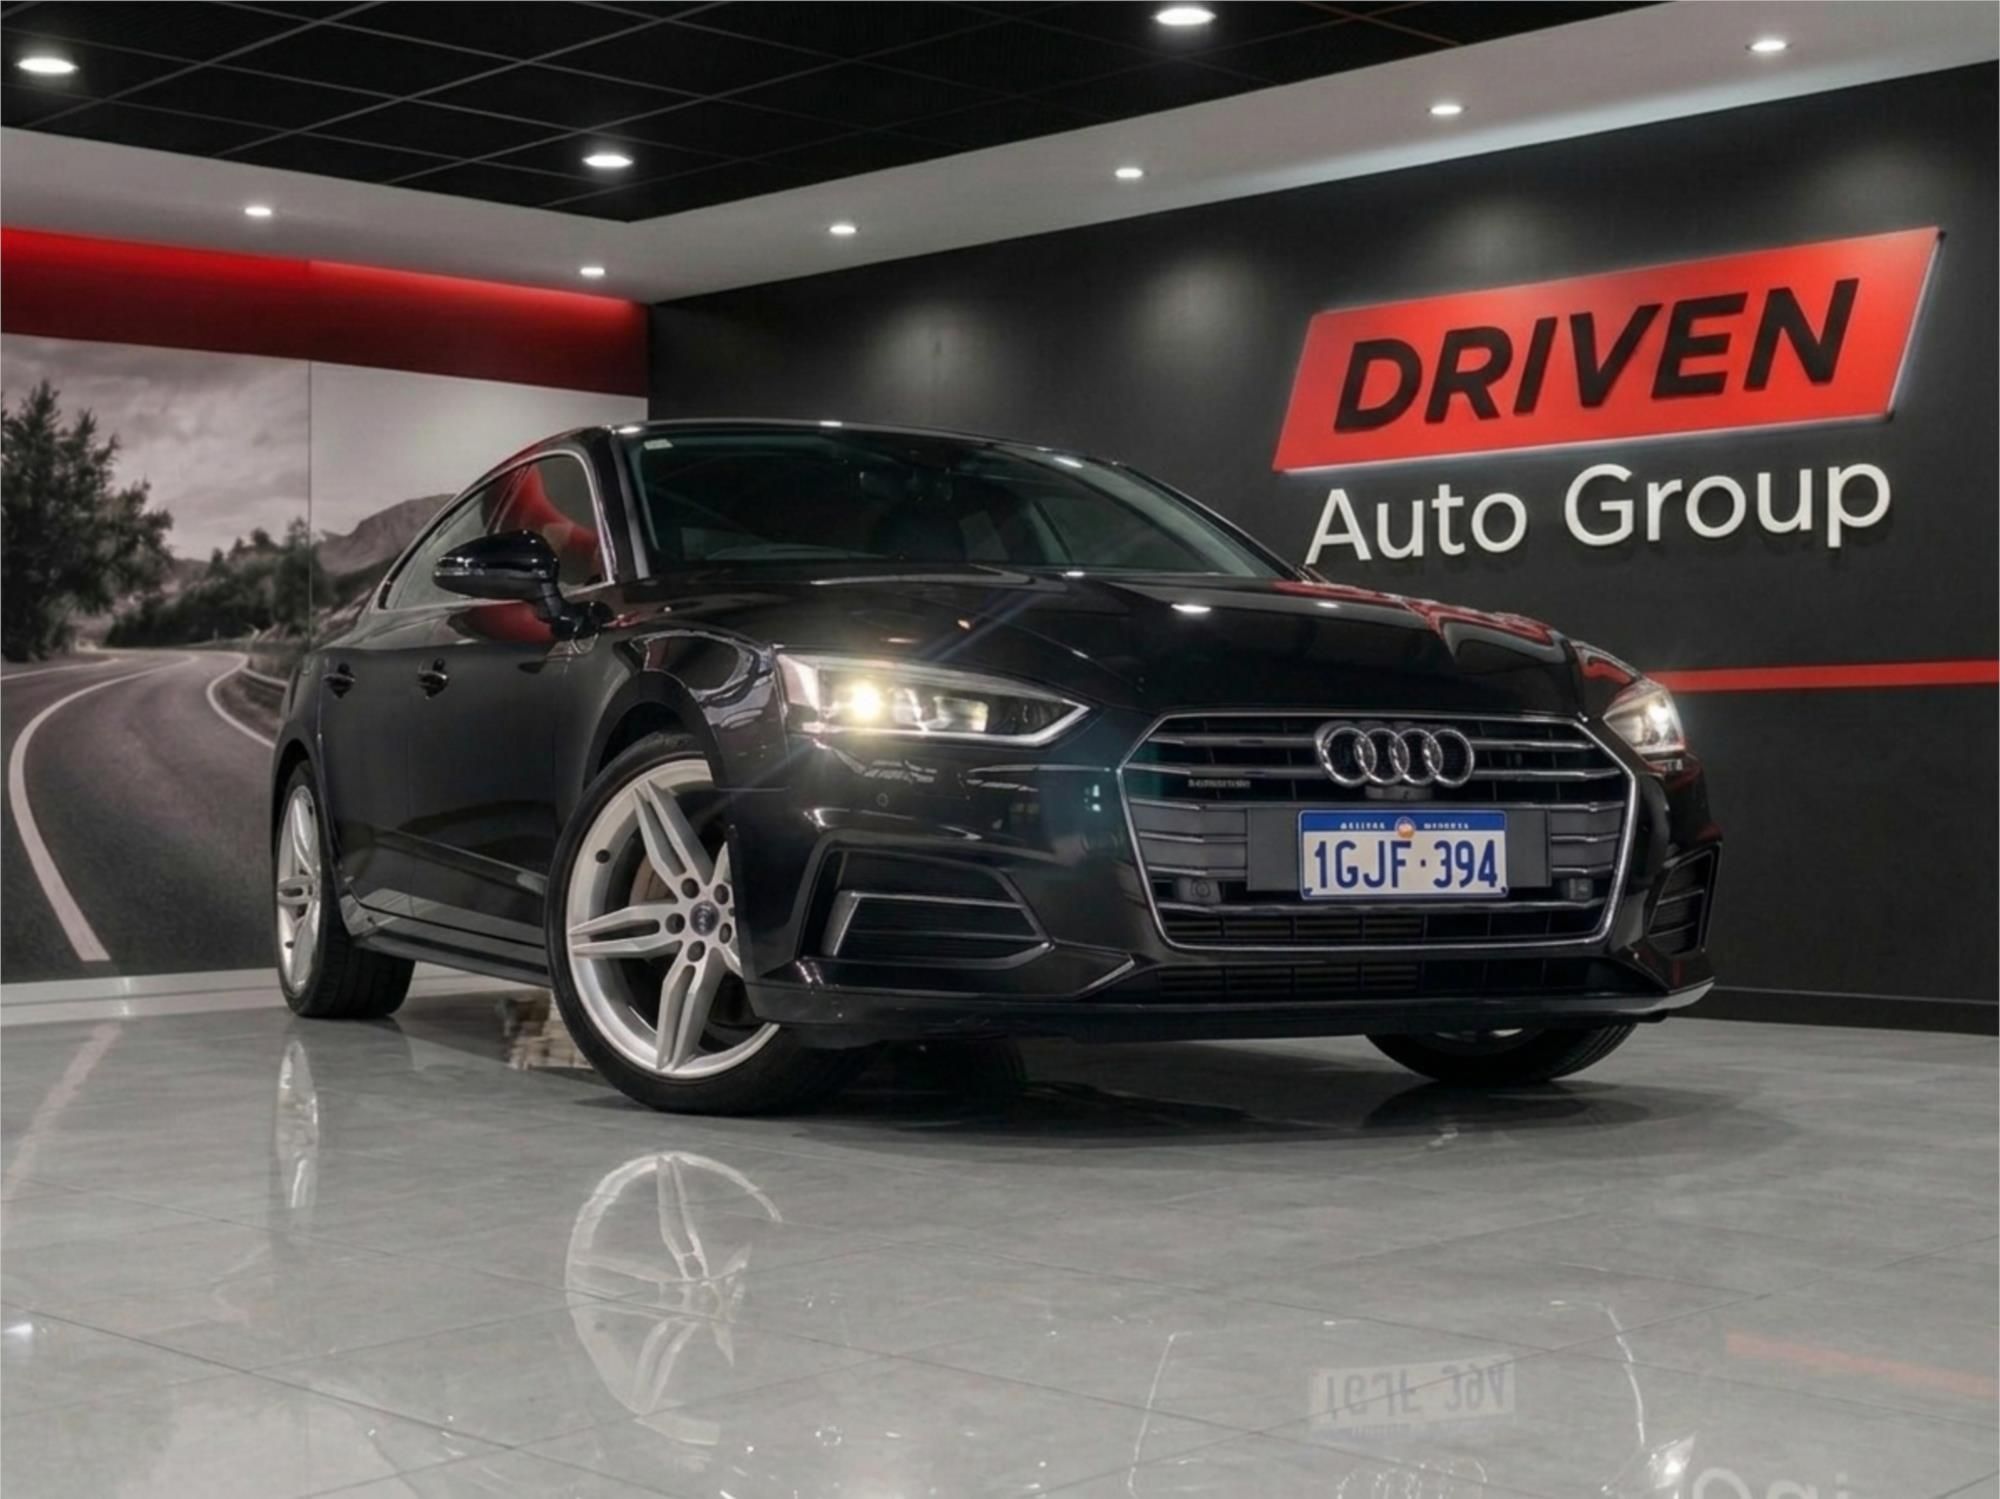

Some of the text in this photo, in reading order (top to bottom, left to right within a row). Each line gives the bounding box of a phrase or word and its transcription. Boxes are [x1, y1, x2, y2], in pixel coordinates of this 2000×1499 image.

[1333, 278, 1860, 433] DRIVEN
[1305, 462, 1892, 565] Auto Group
